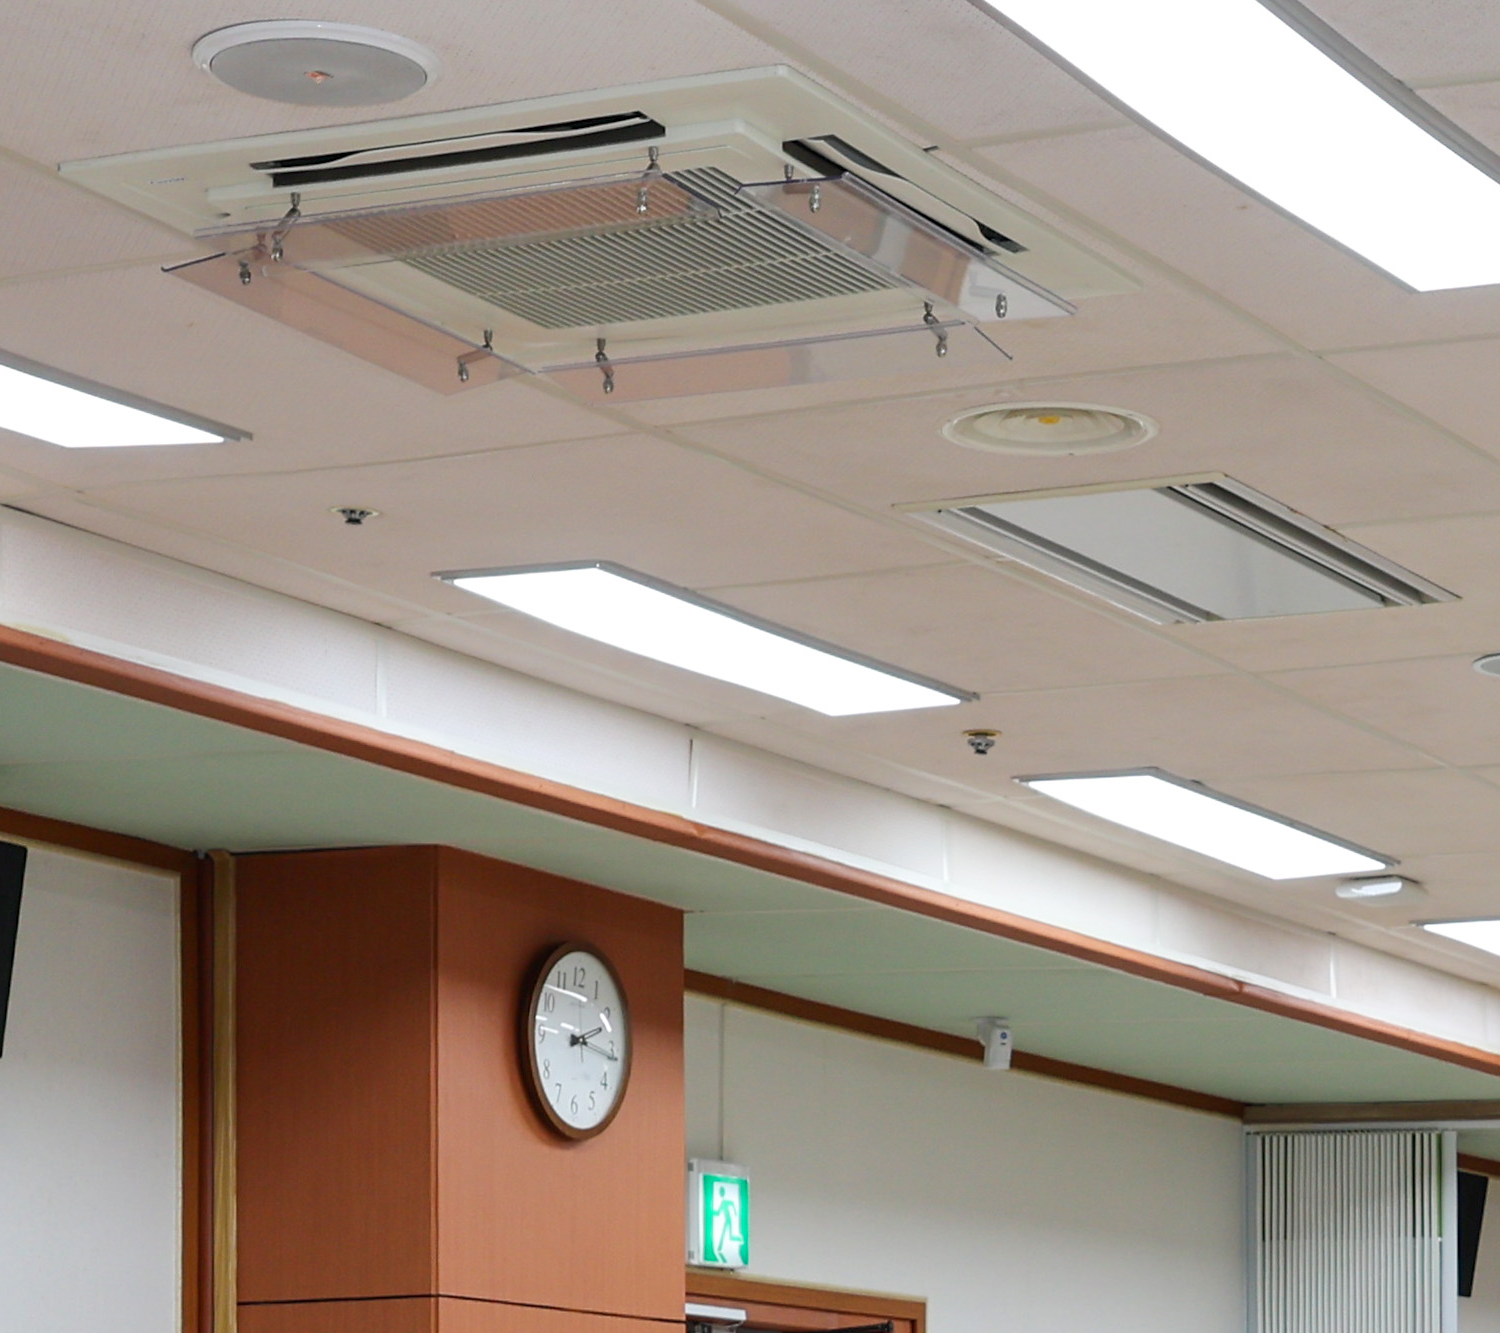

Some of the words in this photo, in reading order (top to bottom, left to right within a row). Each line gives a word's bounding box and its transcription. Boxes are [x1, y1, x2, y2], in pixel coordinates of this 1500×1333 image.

[556, 970, 568, 991] 11
[572, 966, 587, 989] 12
[543, 992, 556, 1014] 10
[542, 1059, 551, 1080] 8
[599, 1071, 609, 1091] 4
[554, 1083, 563, 1104] 7
[587, 1090, 596, 1111] 5
[570, 1094, 579, 1115] 6
